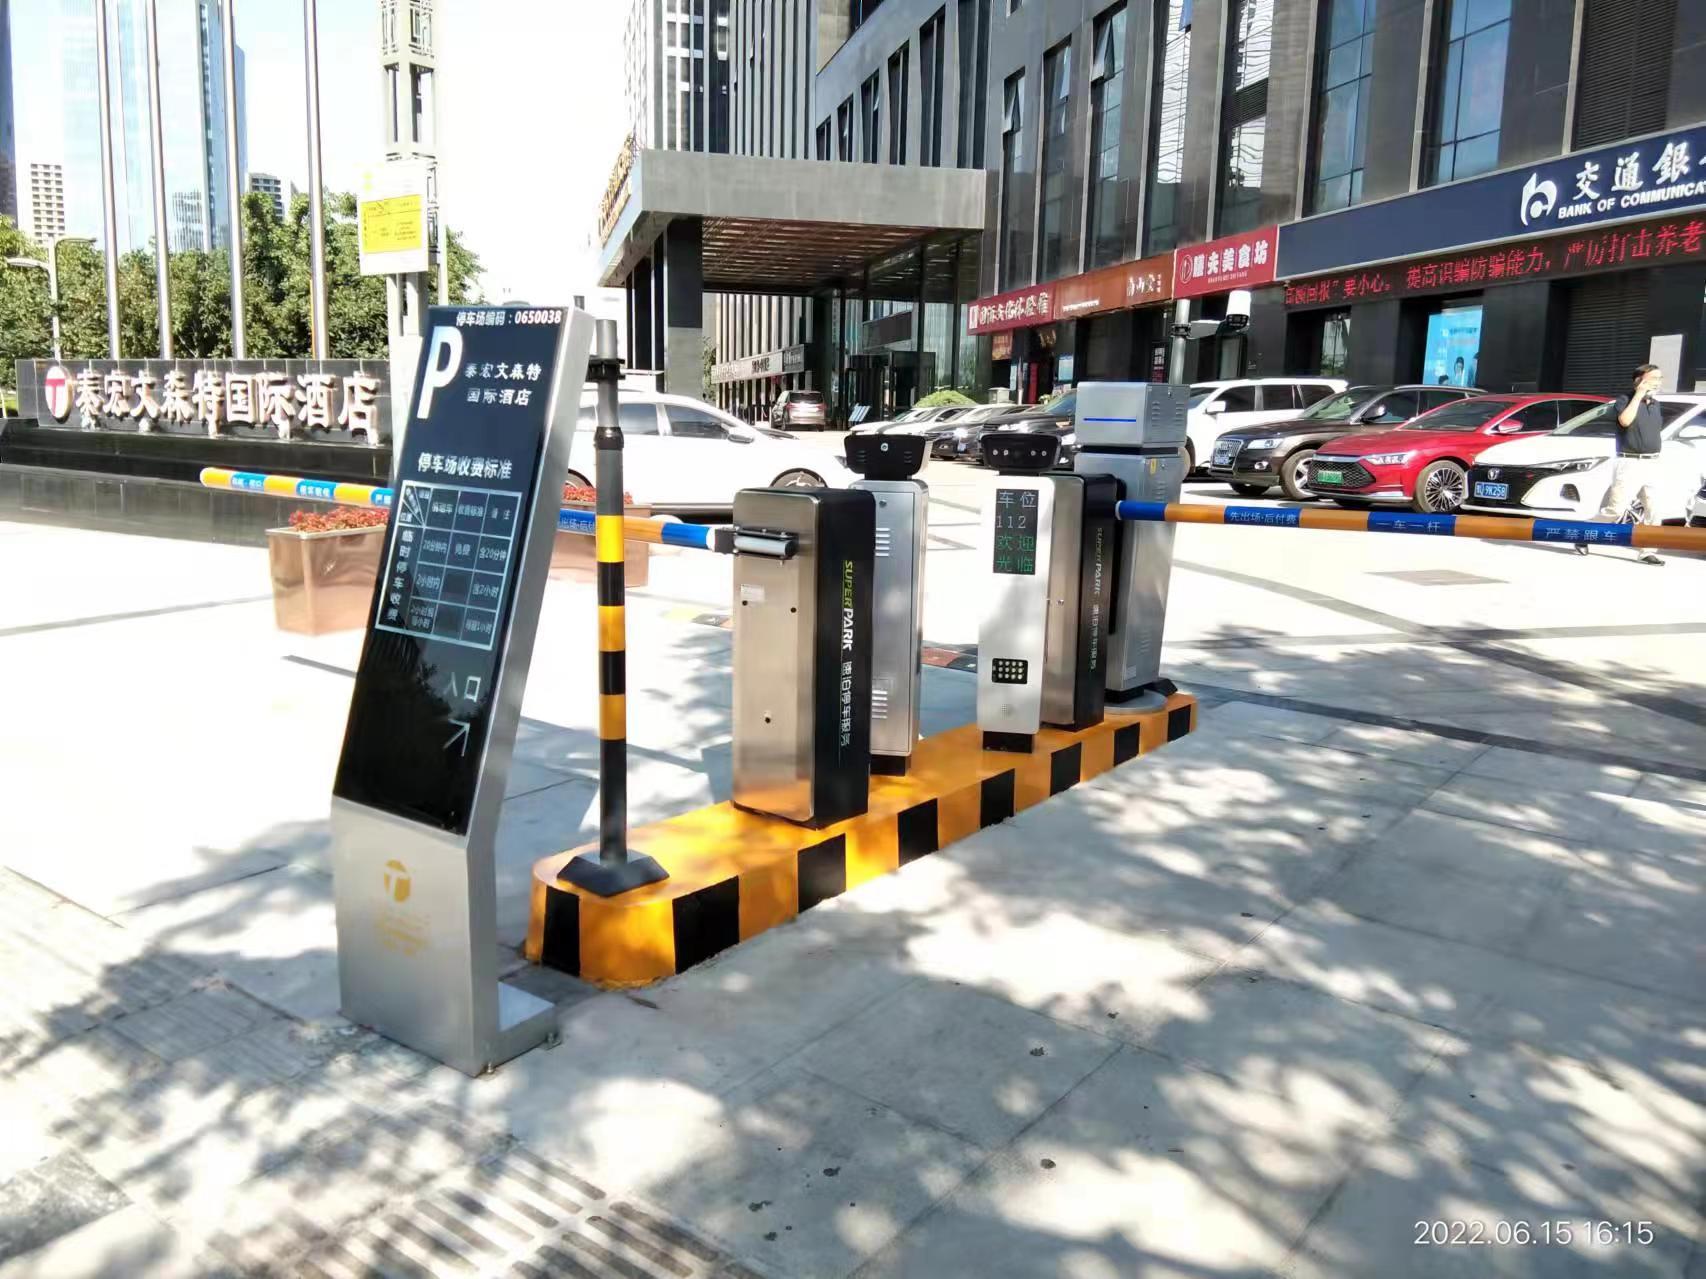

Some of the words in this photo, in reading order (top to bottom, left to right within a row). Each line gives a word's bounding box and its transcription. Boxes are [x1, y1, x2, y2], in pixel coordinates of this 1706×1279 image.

[1572, 141, 1706, 201] 交通銀
[1558, 202, 1592, 219] BANK
[1597, 197, 1616, 211] OF
[456, 310, 562, 326] 停车场编码：0650038
[416, 326, 463, 419] P
[464, 362, 542, 381] 泰宏文森特
[76, 368, 381, 438] 泰宏文森特国际酒店
[466, 388, 533, 406] 国际酒店
[418, 452, 513, 479] 停车场收费标准
[998, 490, 1037, 509] 车位
[996, 515, 1026, 529] 112
[1230, 511, 1297, 525] 先出场·后付费
[1376, 519, 1441, 533] 一车一杆
[997, 535, 1035, 551] 欢迎
[1546, 527, 1617, 542] 严禁跟车
[996, 555, 1033, 573] 光临
